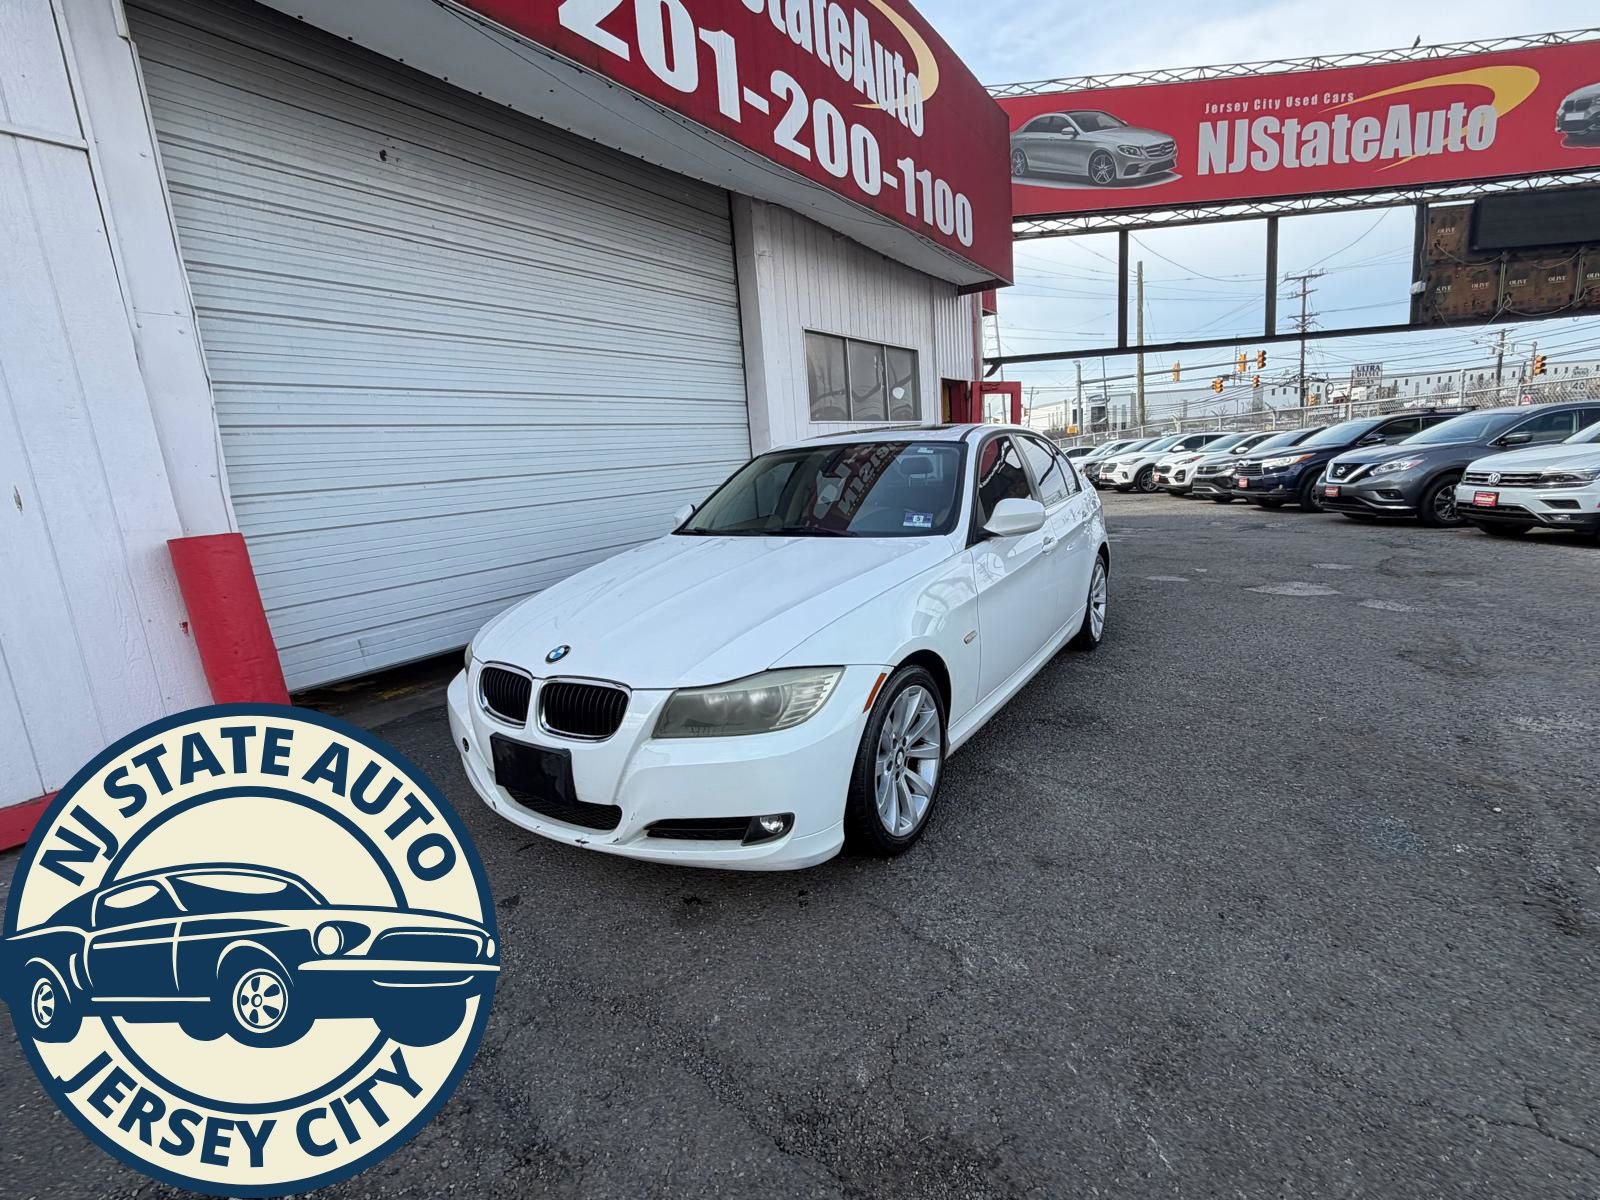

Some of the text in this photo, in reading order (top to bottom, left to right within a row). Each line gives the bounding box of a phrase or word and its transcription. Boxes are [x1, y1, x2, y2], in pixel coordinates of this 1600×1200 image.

[741, 0, 924, 137] tateAuto
[1205, 92, 1354, 114] Jersey City Used Cars
[1197, 102, 1497, 175] NJStateAuto
